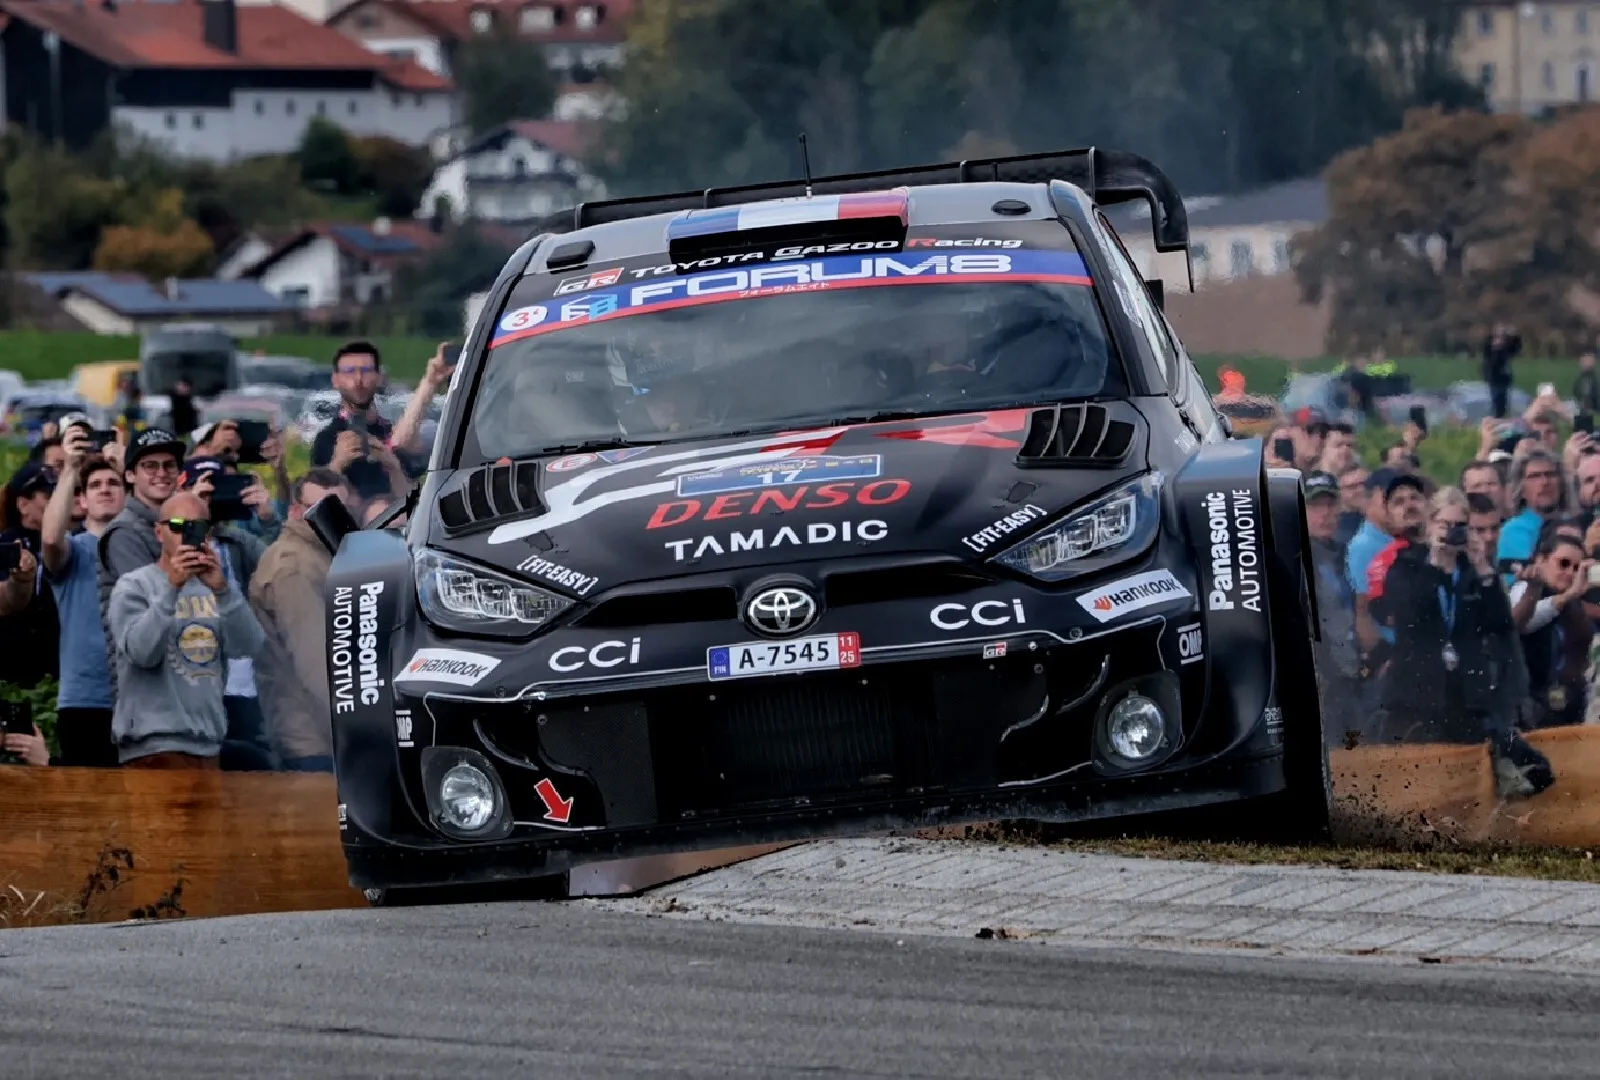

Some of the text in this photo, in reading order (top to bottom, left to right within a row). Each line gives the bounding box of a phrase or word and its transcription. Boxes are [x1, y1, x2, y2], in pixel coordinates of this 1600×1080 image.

[630, 237, 1023, 278] TOYOTA GAZOO Racing
[631, 254, 1012, 307] FORUM8
[556, 273, 617, 295] GR
[757, 469, 802, 485] 17
[645, 478, 912, 530] DENSO
[664, 519, 888, 561] TAMADIC
[1201, 492, 1234, 611] Panasonic
[1232, 489, 1261, 612] AUTOMOTIVE
[332, 586, 355, 715] AUTOMOTIVE
[358, 580, 385, 706] Panasonic
[738, 641, 830, 670] A-7545
[840, 651, 855, 664] 25
